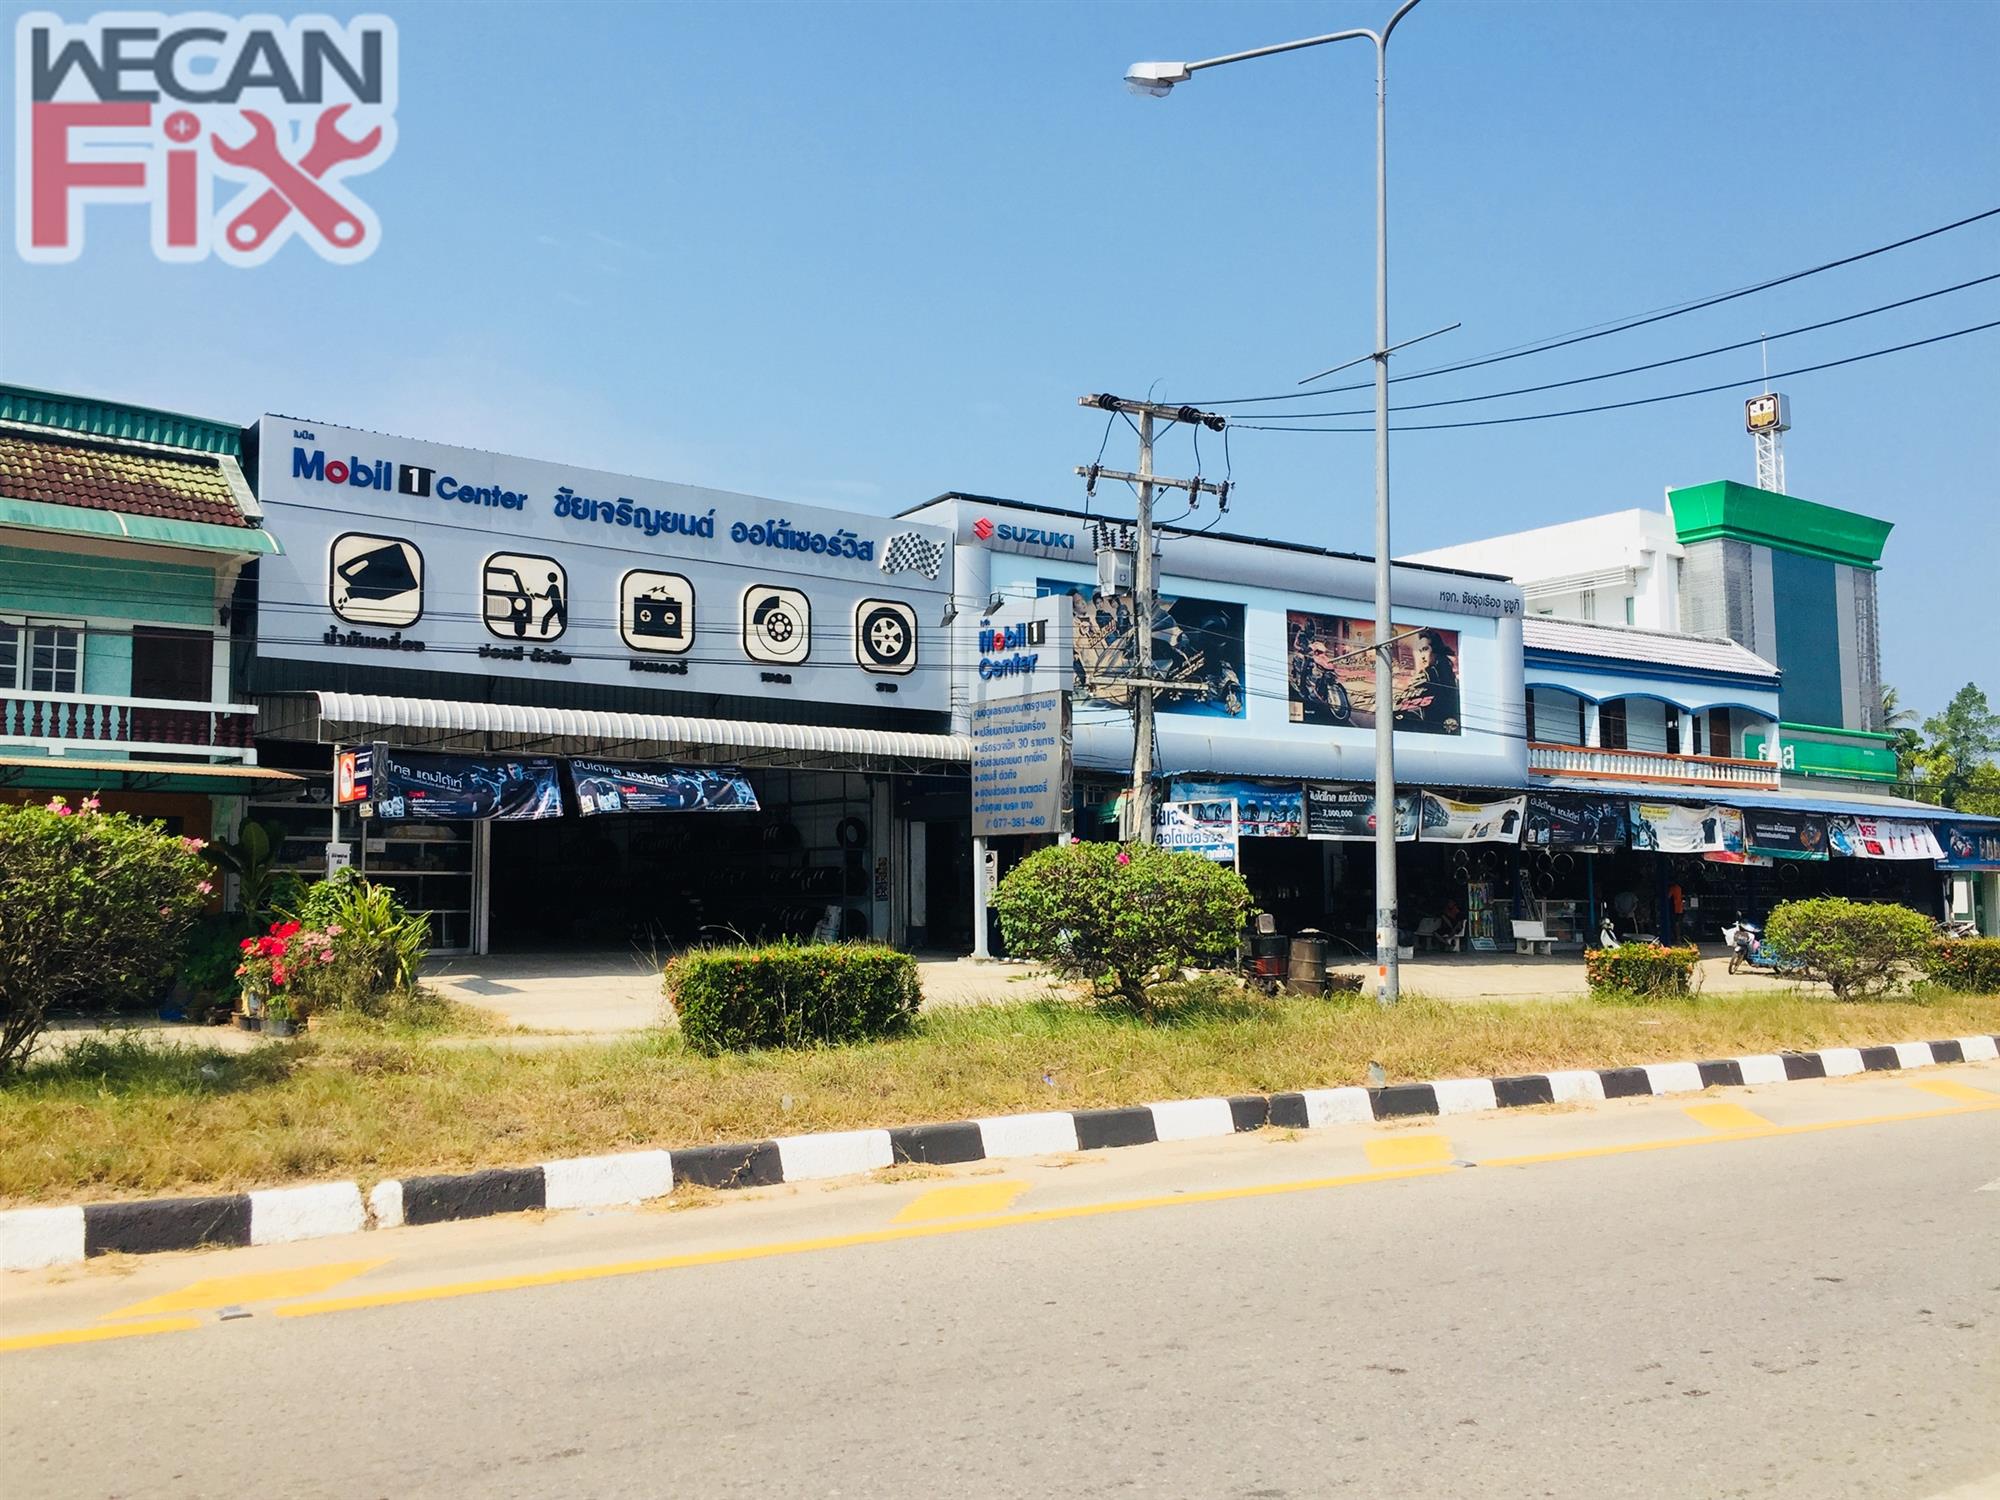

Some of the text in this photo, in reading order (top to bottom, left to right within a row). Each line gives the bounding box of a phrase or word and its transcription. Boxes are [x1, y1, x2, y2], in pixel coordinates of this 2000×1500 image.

[293, 447, 392, 491] Mobil
[436, 476, 528, 511] Center
[554, 487, 874, 561] ชัยเจริญยนต์ ออโต้เซอร์วิส
[997, 523, 1075, 550] SUZUKI
[979, 623, 1026, 653] Mobil
[979, 652, 1038, 680] Center
[1018, 737, 1029, 748] 30
[992, 815, 1046, 829] 077-381-480
